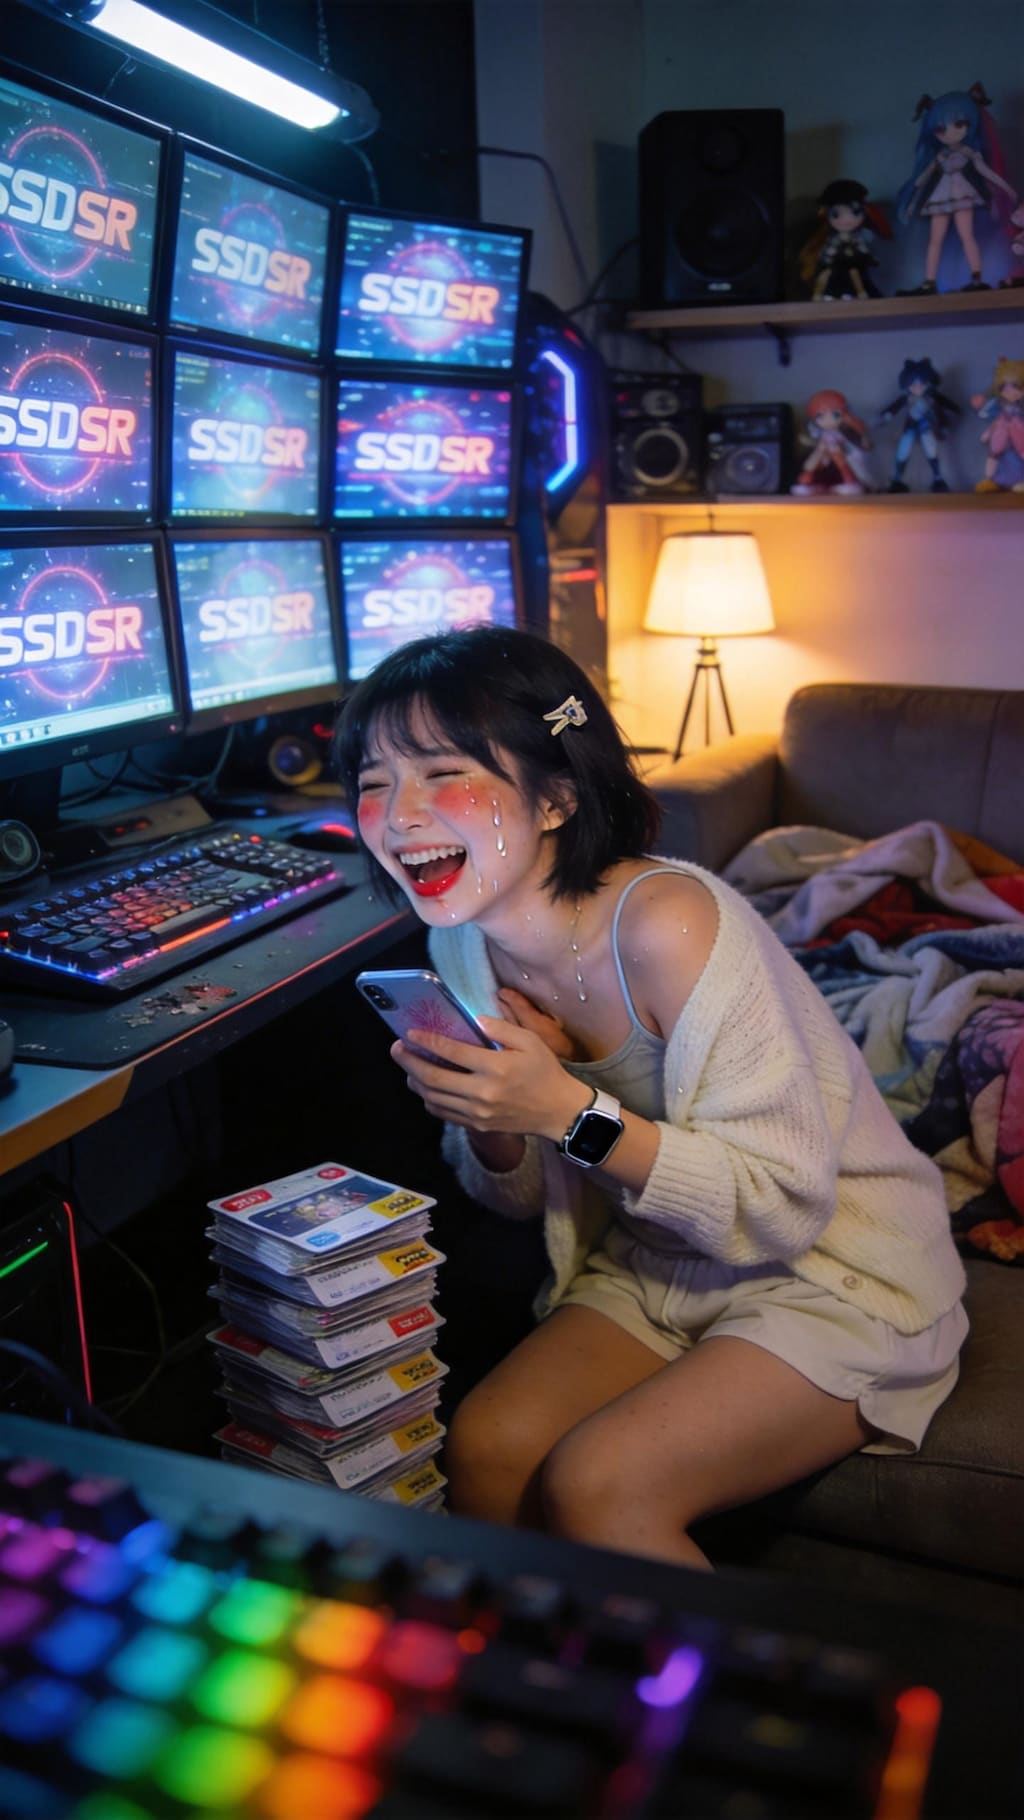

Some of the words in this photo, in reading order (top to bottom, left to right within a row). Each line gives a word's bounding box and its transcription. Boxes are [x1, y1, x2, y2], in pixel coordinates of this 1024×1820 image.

[192, 228, 312, 299] SSDSR
[358, 272, 500, 325] SSDSR
[188, 418, 307, 469] SSDSR
[355, 432, 494, 475] SSDSR
[200, 592, 314, 642] SSDSR
[363, 585, 495, 627] SSDSR
[0, 606, 142, 667] SSDSR
